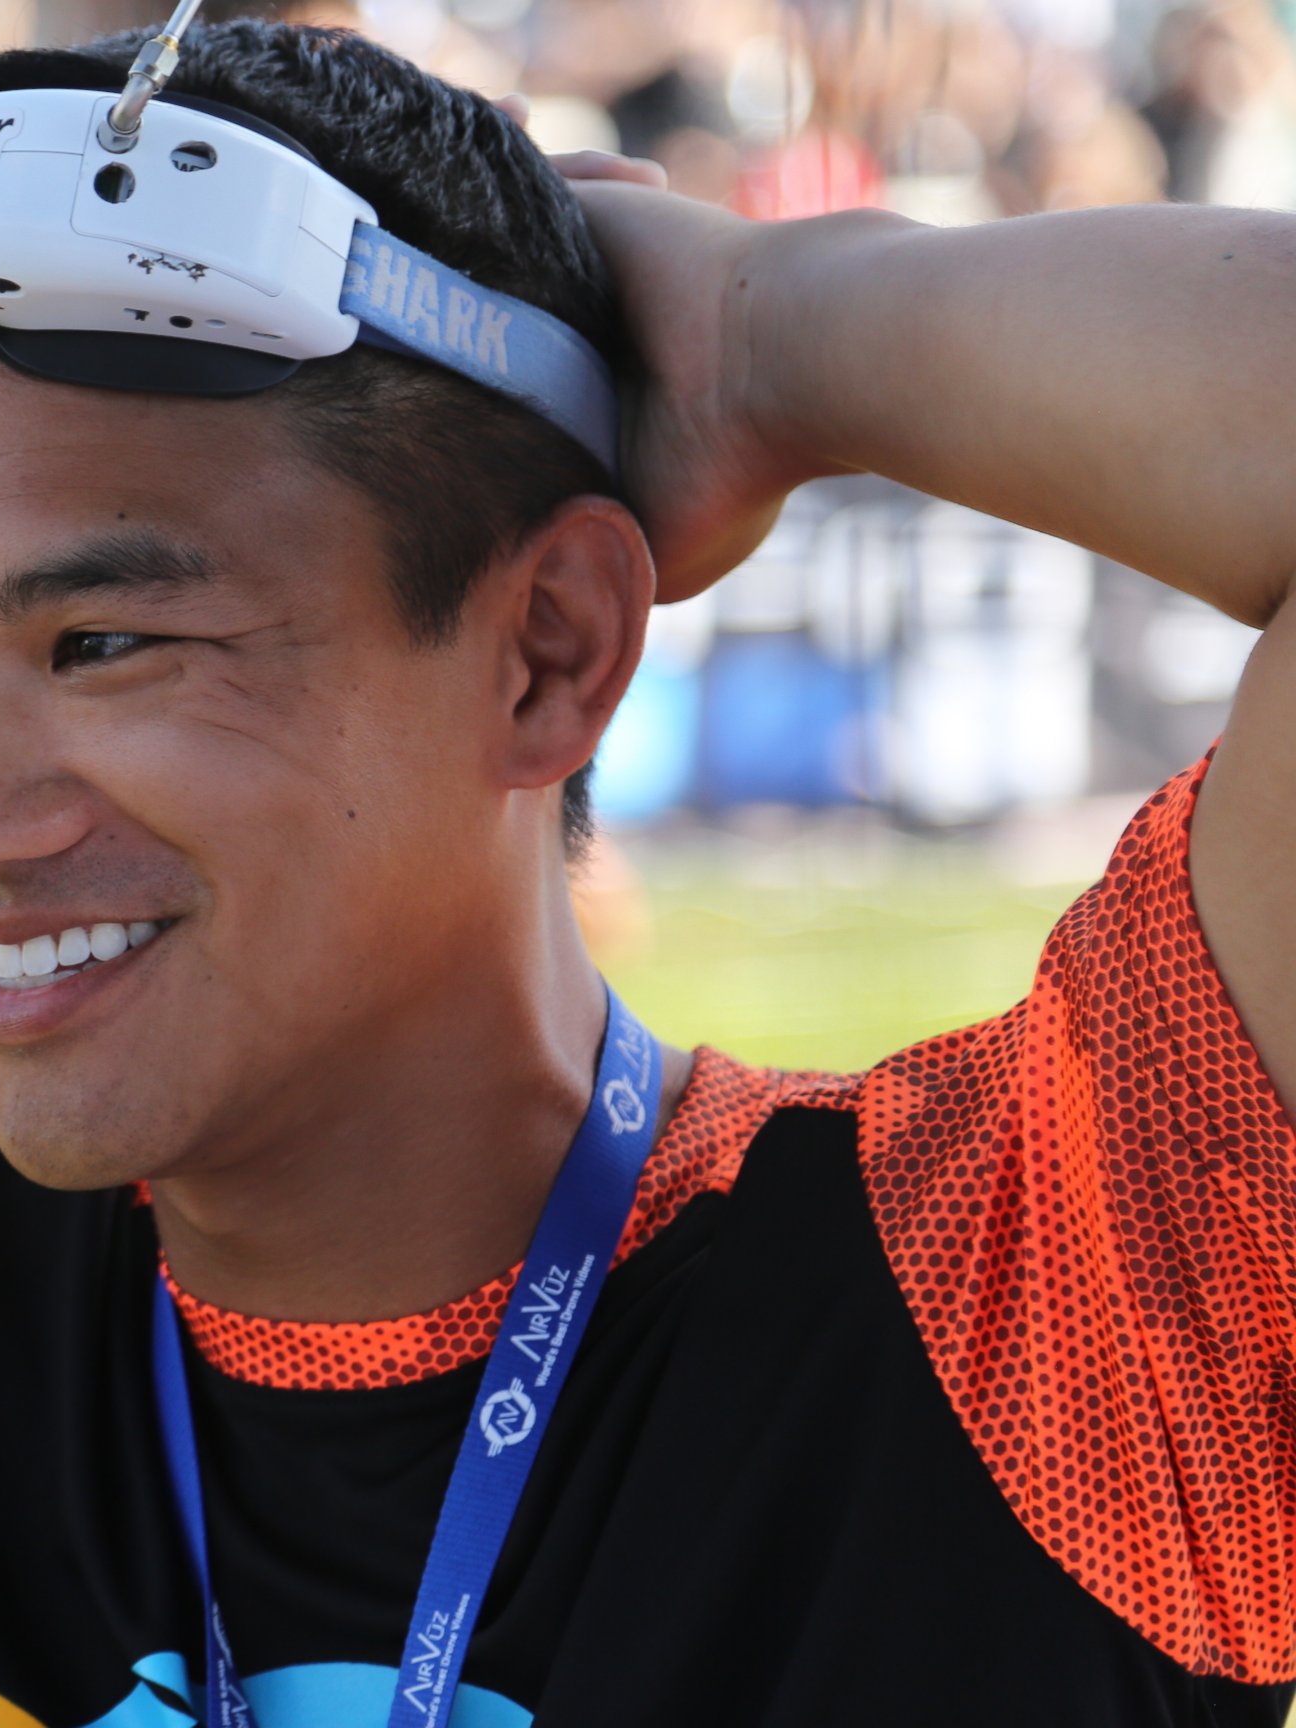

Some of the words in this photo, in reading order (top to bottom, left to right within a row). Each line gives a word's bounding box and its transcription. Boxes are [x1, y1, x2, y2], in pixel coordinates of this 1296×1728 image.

[572, 1253, 595, 1289] Videos
[559, 1289, 582, 1322] Drone
[550, 1321, 569, 1347] Best
[534, 1346, 559, 1387] World's
[432, 1668, 448, 1695] Best
[440, 1632, 458, 1667] Drone
[450, 1593, 470, 1631] Videos
